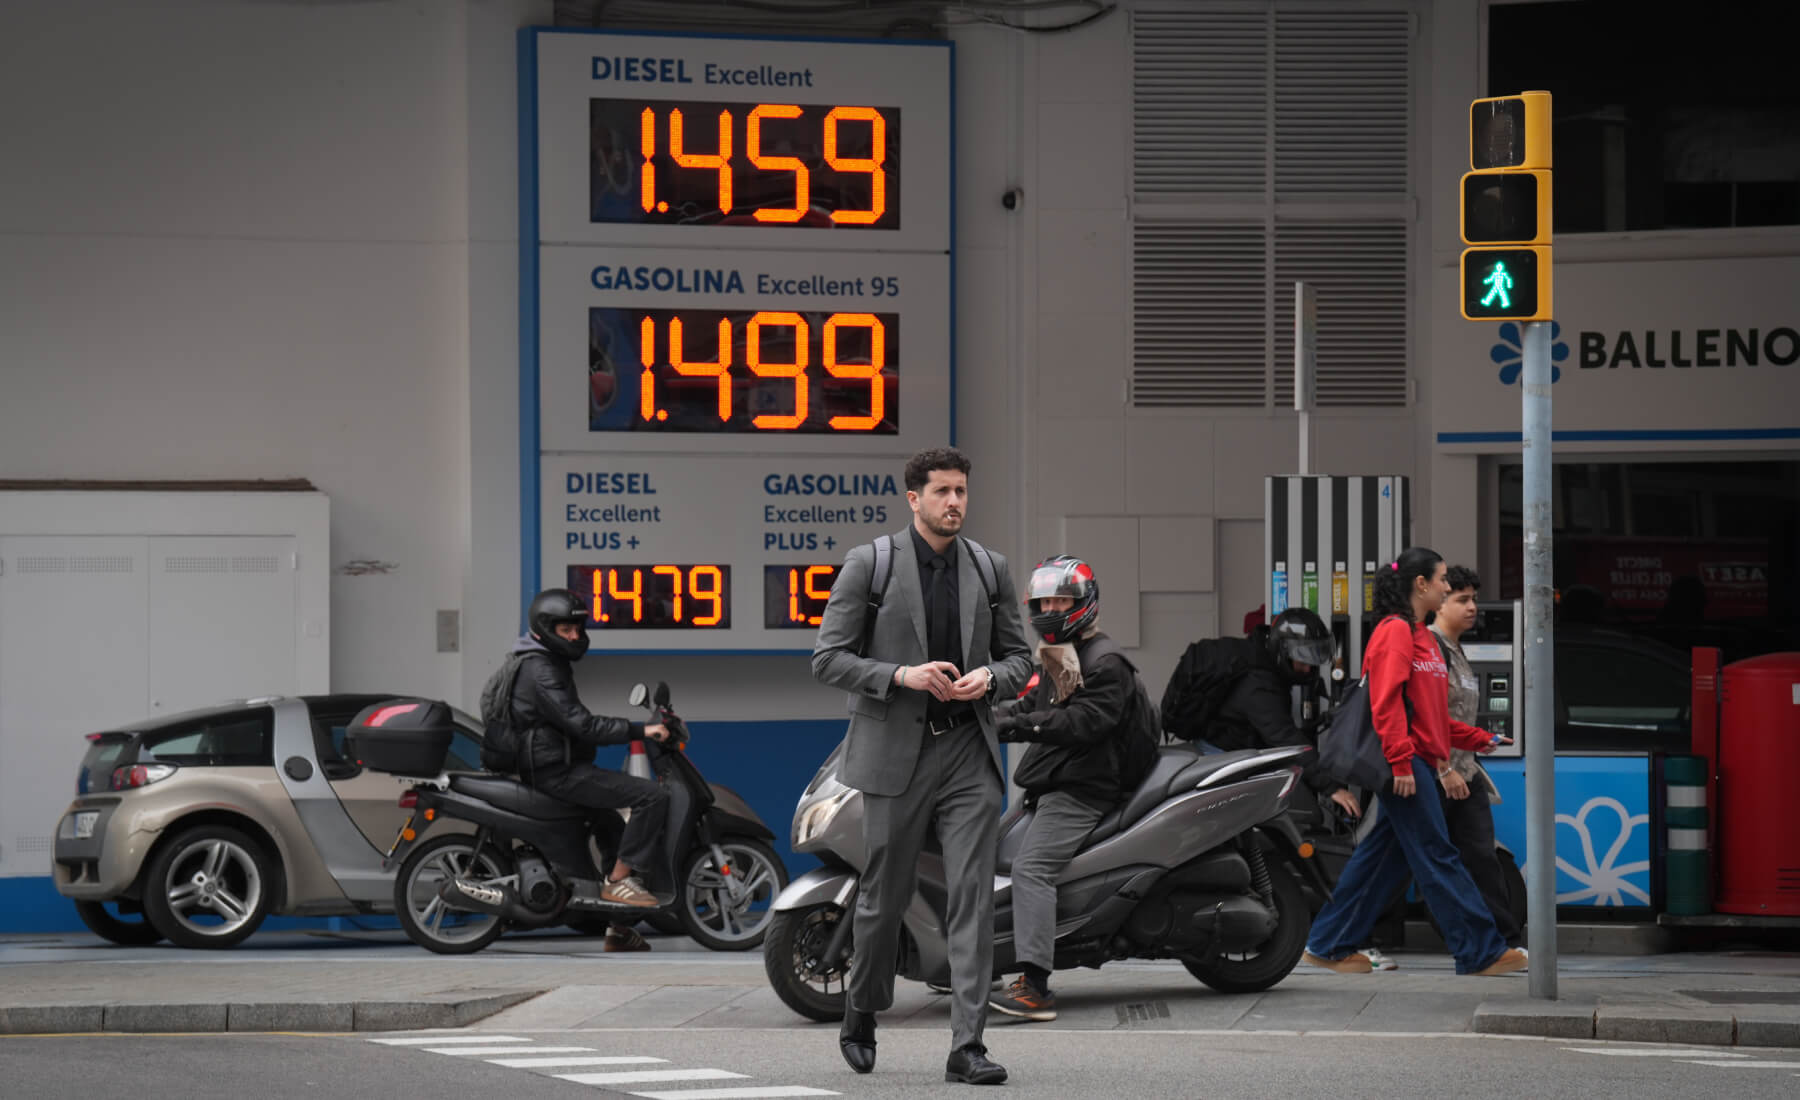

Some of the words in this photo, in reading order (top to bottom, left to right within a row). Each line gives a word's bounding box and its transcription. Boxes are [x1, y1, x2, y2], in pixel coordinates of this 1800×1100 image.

[591, 56, 693, 83] DIESEL
[704, 64, 813, 88] Excellent
[640, 104, 886, 225] 1.459
[590, 266, 745, 294] GASOLINA
[756, 274, 864, 296] Excellent
[871, 277, 899, 297] 95
[1579, 327, 1800, 369] BALLENO
[640, 311, 885, 431] 1.499
[566, 473, 656, 494] DIESEL
[764, 474, 897, 496] GASOLINA
[1381, 484, 1390, 499] 4
[566, 504, 661, 523] Excellent
[764, 505, 856, 523] Excellent
[862, 506, 887, 524] 95
[566, 533, 621, 550] PLUS
[764, 533, 818, 550] PLUS
[592, 565, 722, 626] 1.479
[789, 565, 834, 626] 1.5
